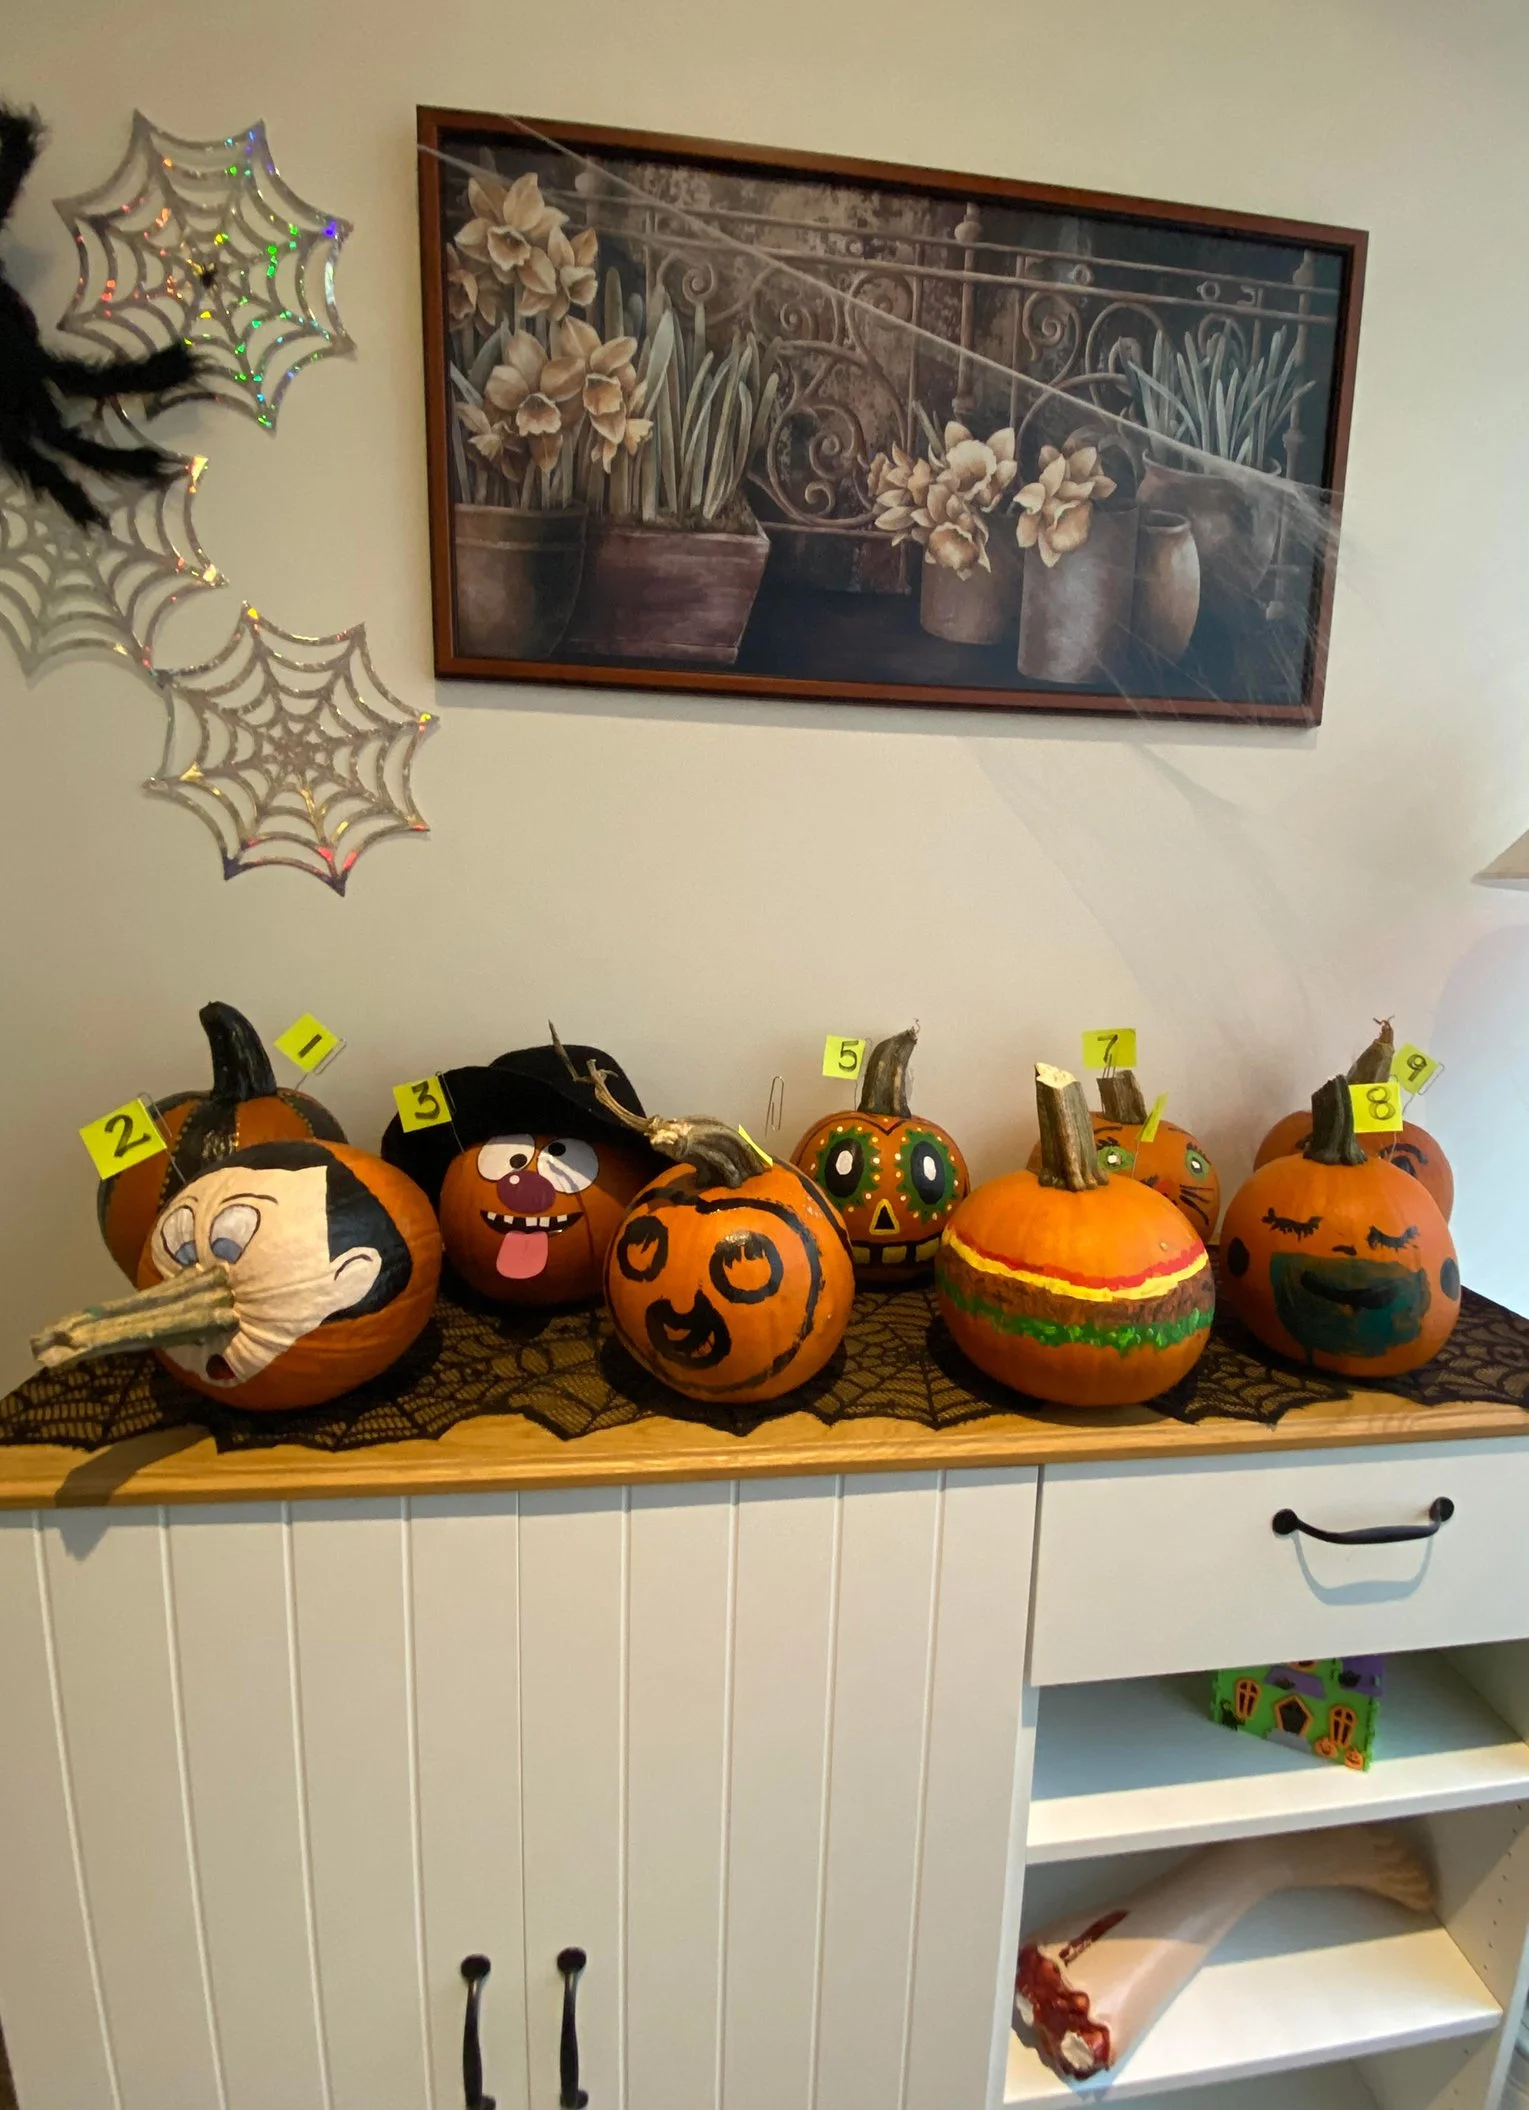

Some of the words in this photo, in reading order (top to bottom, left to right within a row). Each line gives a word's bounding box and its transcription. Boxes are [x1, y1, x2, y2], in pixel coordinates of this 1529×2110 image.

[838, 1040, 859, 1072] 5
[1097, 1034, 1118, 1063] 7
[1407, 1054, 1427, 1082] 9
[412, 1080, 441, 1120] 3
[1366, 1086, 1396, 1120] 8
[104, 1114, 152, 1157] 2
